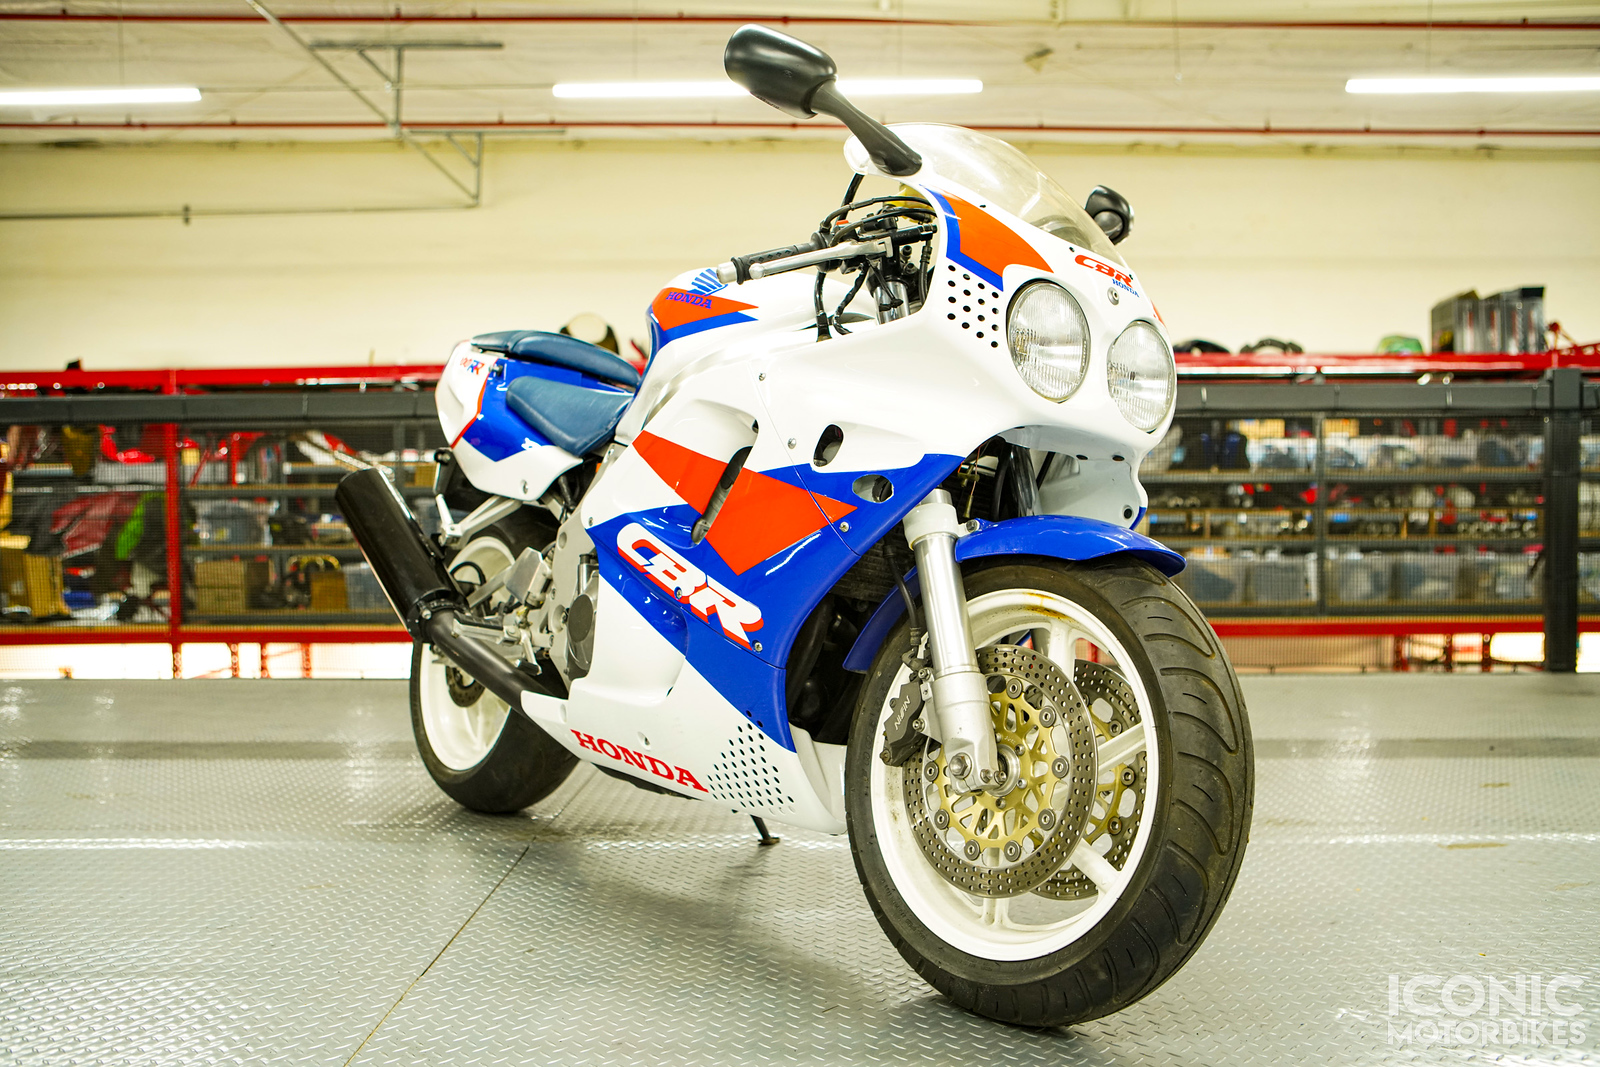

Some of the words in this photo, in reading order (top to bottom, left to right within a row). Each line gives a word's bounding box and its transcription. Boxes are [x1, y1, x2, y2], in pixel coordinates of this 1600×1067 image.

[1075, 254, 1133, 288] CBR
[1112, 278, 1140, 298] HONDA
[666, 291, 712, 309] HONDA
[617, 522, 764, 651] CBR
[570, 729, 709, 793] HONDA
